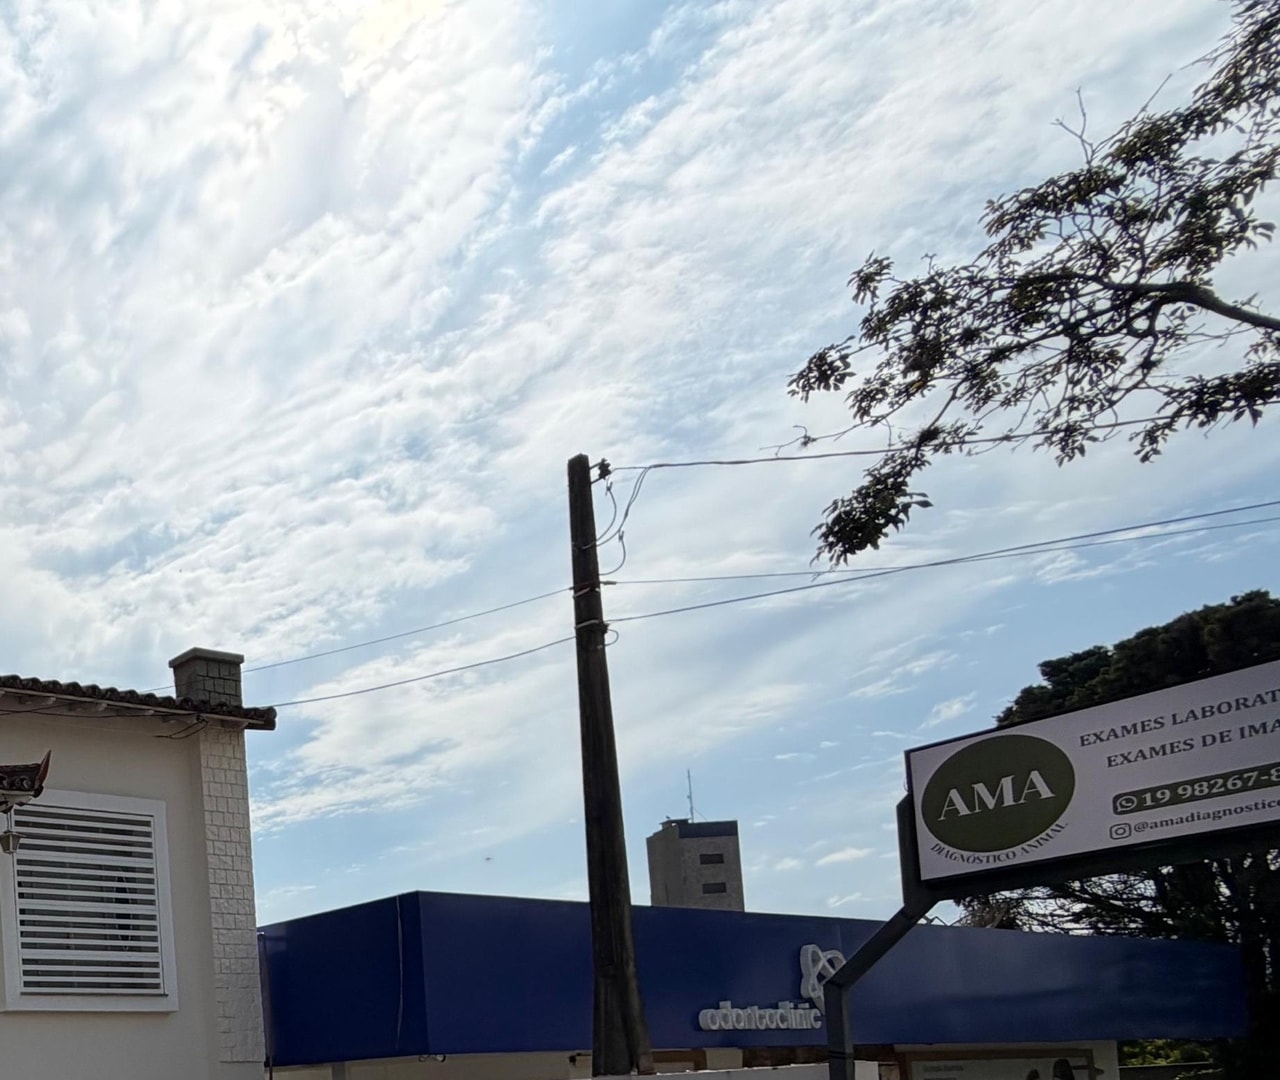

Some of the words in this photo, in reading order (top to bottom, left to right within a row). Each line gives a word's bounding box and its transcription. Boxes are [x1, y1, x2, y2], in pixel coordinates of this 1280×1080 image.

[1080, 716, 1165, 748] EXAMES
[1107, 738, 1194, 768] EXAMES
[1202, 729, 1232, 748] DE
[938, 769, 1055, 821] AMA
[1142, 788, 1170, 807] 19
[930, 842, 1017, 865] DIAGNÓSTICO
[1020, 822, 1069, 857] ANIMAL
[698, 1000, 823, 1031] odontoclinic
